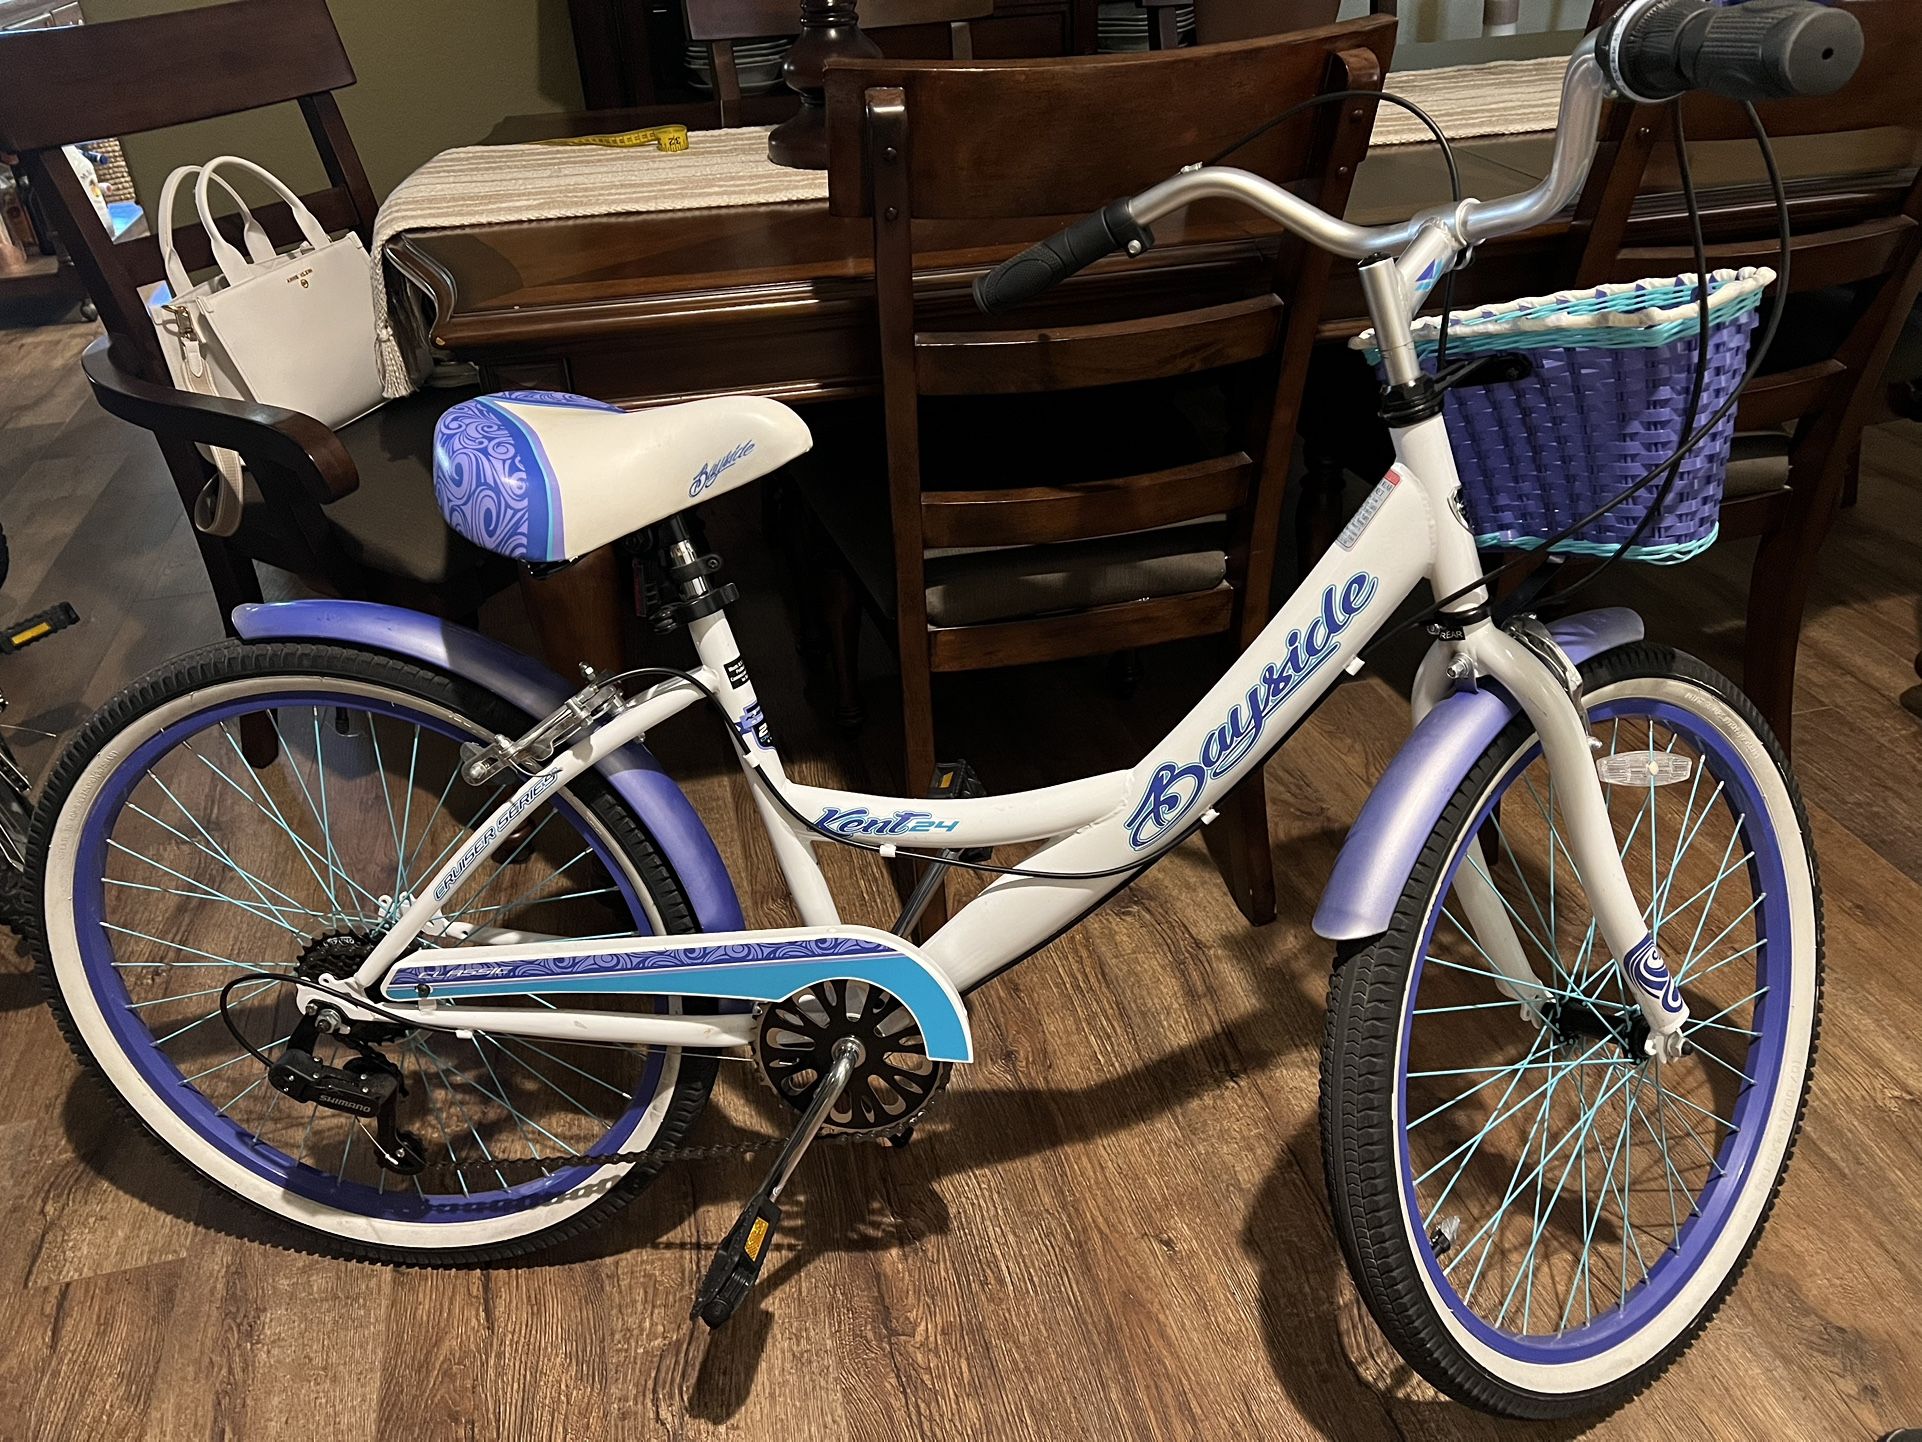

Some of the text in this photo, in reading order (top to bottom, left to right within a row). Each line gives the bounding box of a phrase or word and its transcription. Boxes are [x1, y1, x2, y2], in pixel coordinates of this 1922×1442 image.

[688, 439, 755, 498] Bayside
[1440, 630, 1463, 639] REAR
[1124, 571, 1379, 851] Bayside
[434, 767, 558, 901] CRUISER SERIES
[812, 807, 960, 838] Kent 24
[418, 966, 513, 979] CLASSIC
[320, 1095, 371, 1112] SHIMANO
